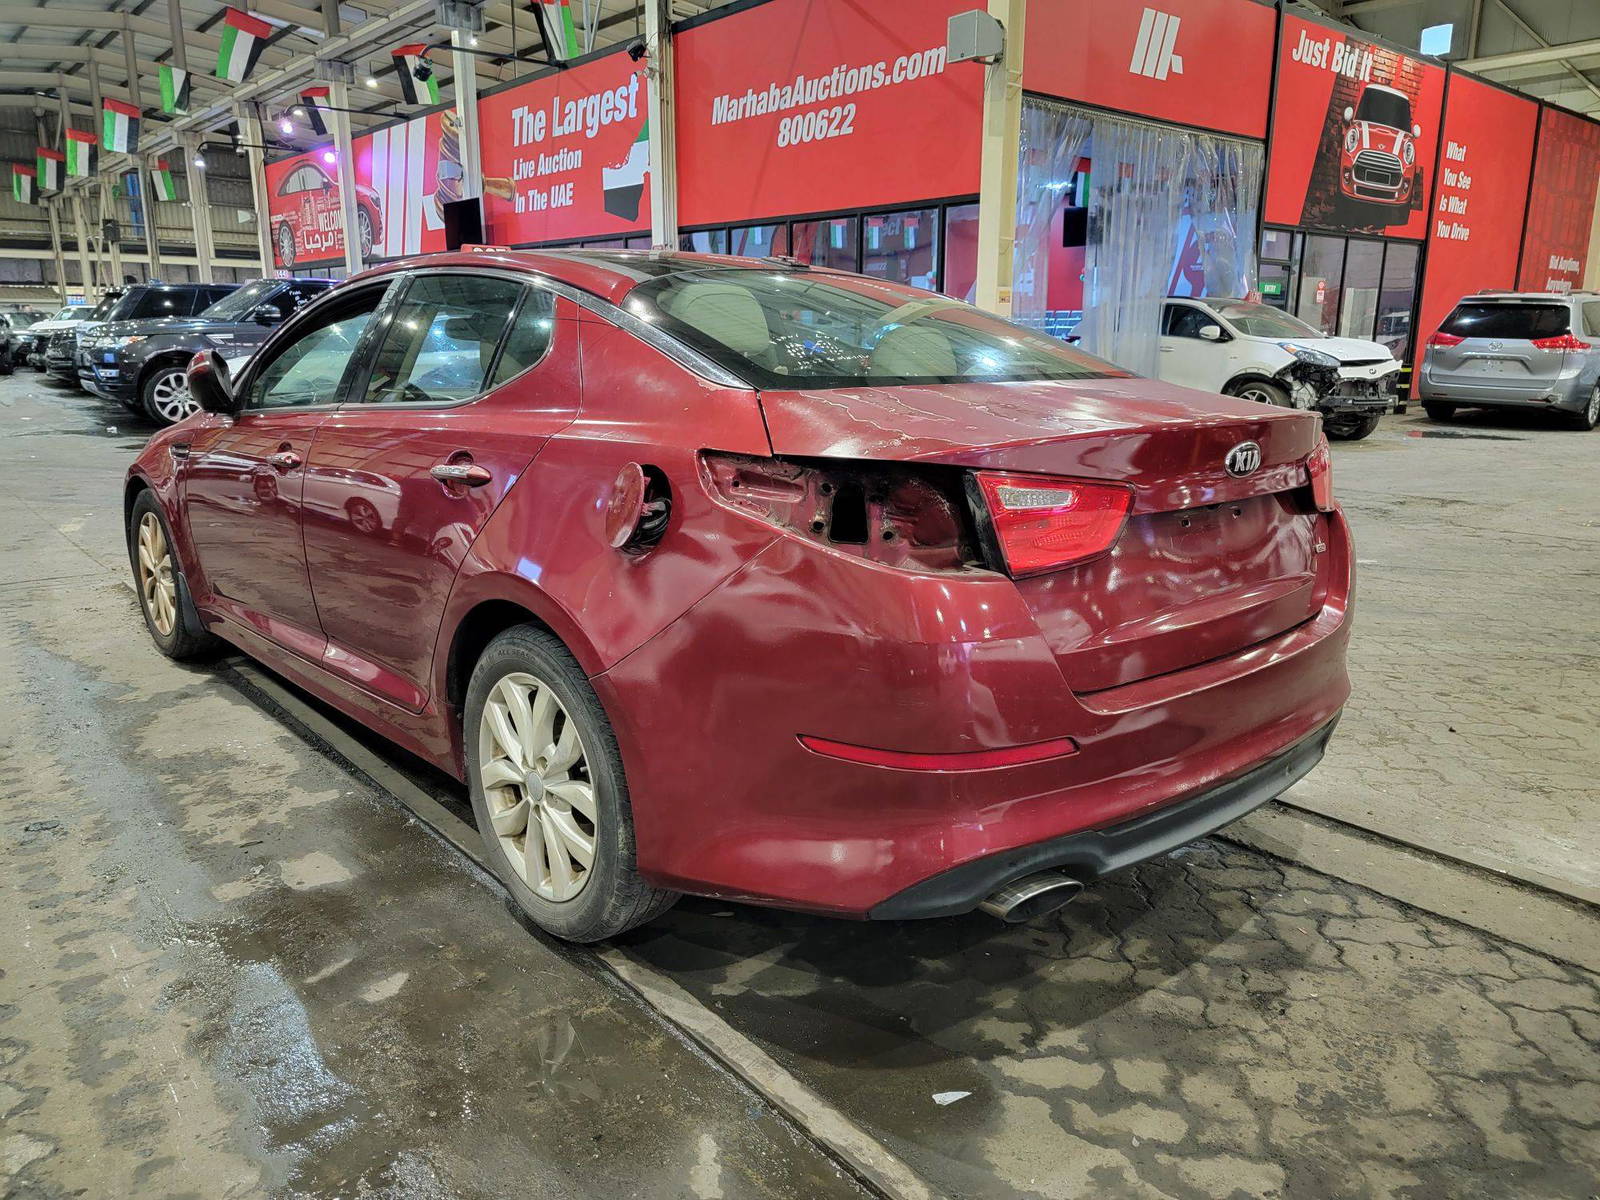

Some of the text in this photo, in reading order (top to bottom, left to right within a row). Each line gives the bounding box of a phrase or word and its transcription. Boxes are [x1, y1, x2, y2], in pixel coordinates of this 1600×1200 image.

[1292, 29, 1373, 83] Just Bid It
[711, 46, 947, 125] MarhabaAuctions.com
[511, 73, 639, 147] The Largest
[777, 103, 856, 147] 800622
[513, 147, 583, 181] Live Auction
[1446, 141, 1466, 162] What
[1443, 167, 1472, 190] You See
[515, 182, 574, 213] In The UAE
[1439, 194, 1467, 215] Is What
[1436, 220, 1470, 241] You Drive
[1234, 450, 1261, 473] KIA
